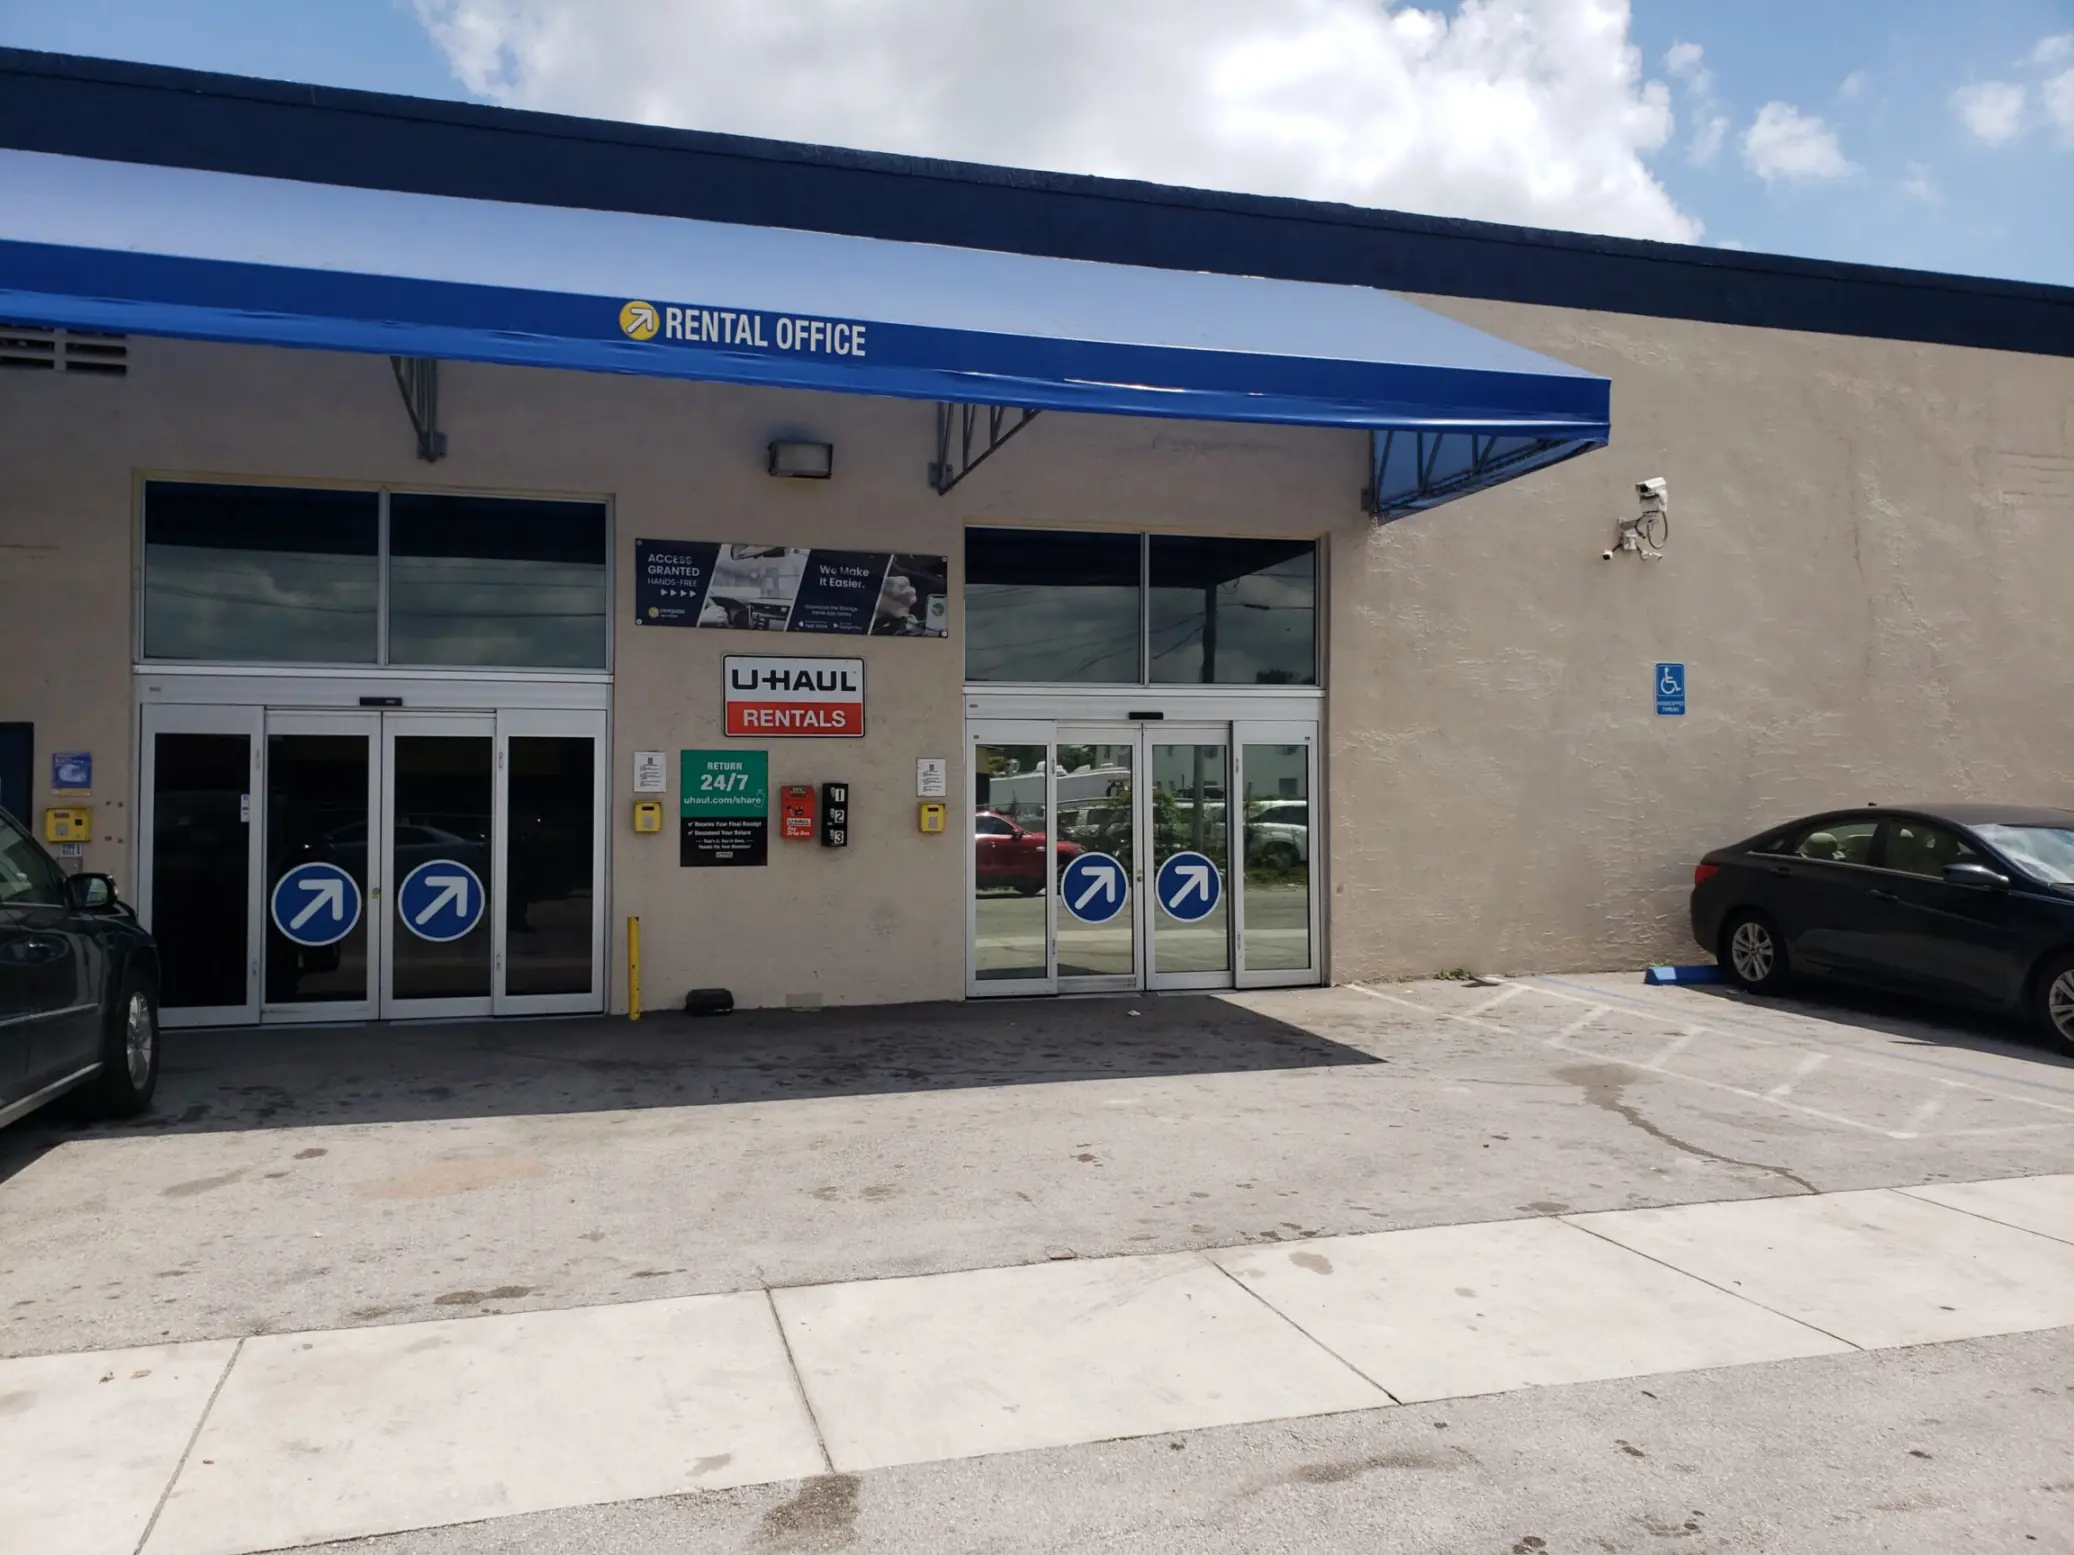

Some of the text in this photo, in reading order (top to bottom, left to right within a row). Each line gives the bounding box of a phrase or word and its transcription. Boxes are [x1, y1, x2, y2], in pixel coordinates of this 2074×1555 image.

[666, 307, 866, 356] RENTAL OFFICE
[648, 553, 692, 564] ACCESS
[648, 565, 700, 577] GRANTED
[819, 564, 869, 577] We Make
[648, 577, 698, 587] HANDS-FREE
[819, 577, 865, 588] It Easier.
[732, 669, 856, 691] U-HAUL
[743, 709, 846, 727] RENTALS
[707, 762, 742, 770] RETURN
[700, 773, 749, 792] 24/7
[683, 796, 761, 804] uhaul.com/share
[836, 810, 843, 822] 2
[836, 832, 843, 843] 3
